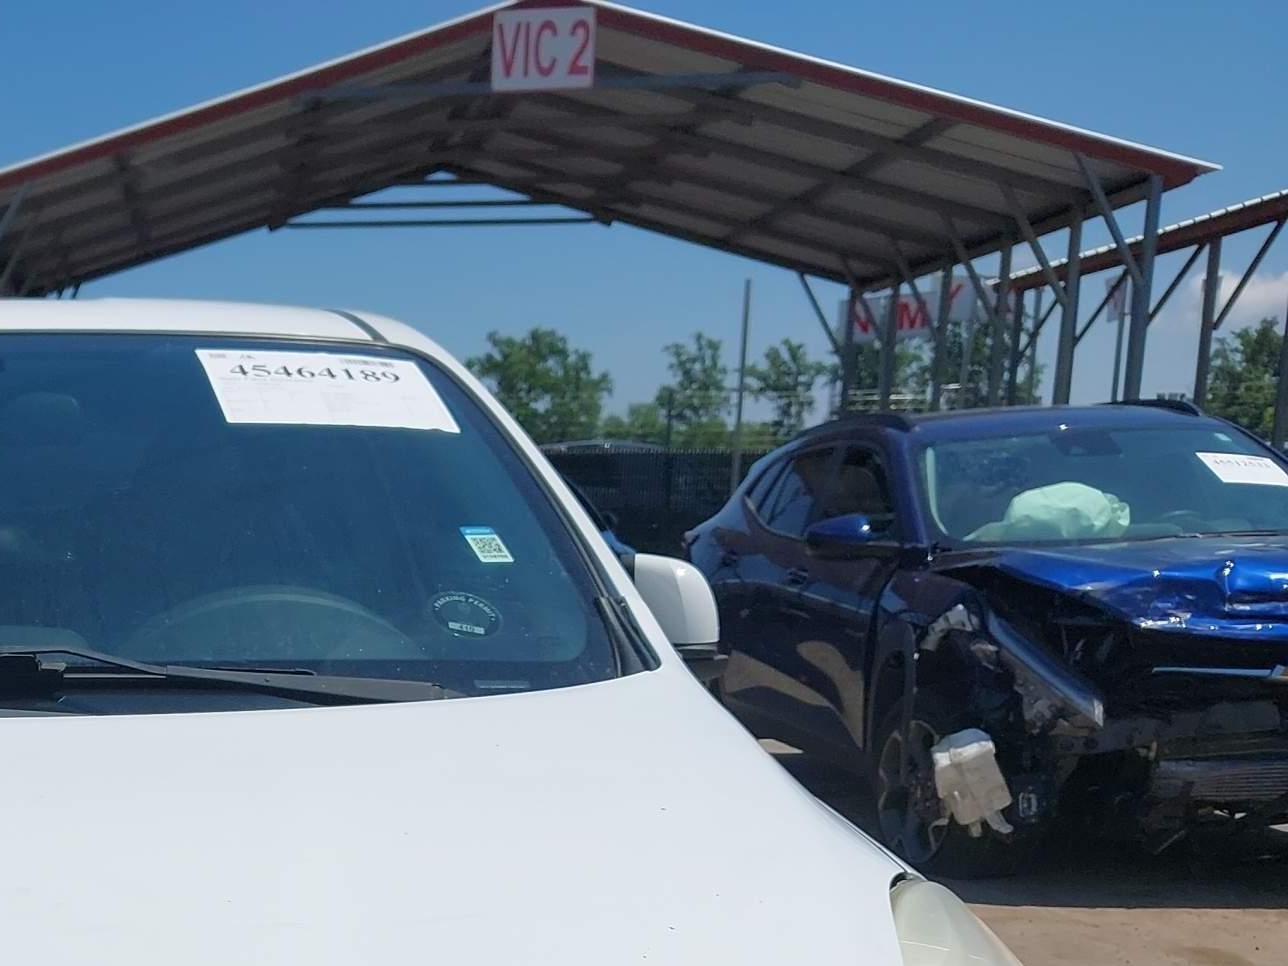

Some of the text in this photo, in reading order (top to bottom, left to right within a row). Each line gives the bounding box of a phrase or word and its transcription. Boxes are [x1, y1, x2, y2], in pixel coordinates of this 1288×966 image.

[499, 19, 589, 77] VIC 2
[229, 363, 401, 383] 45464189
